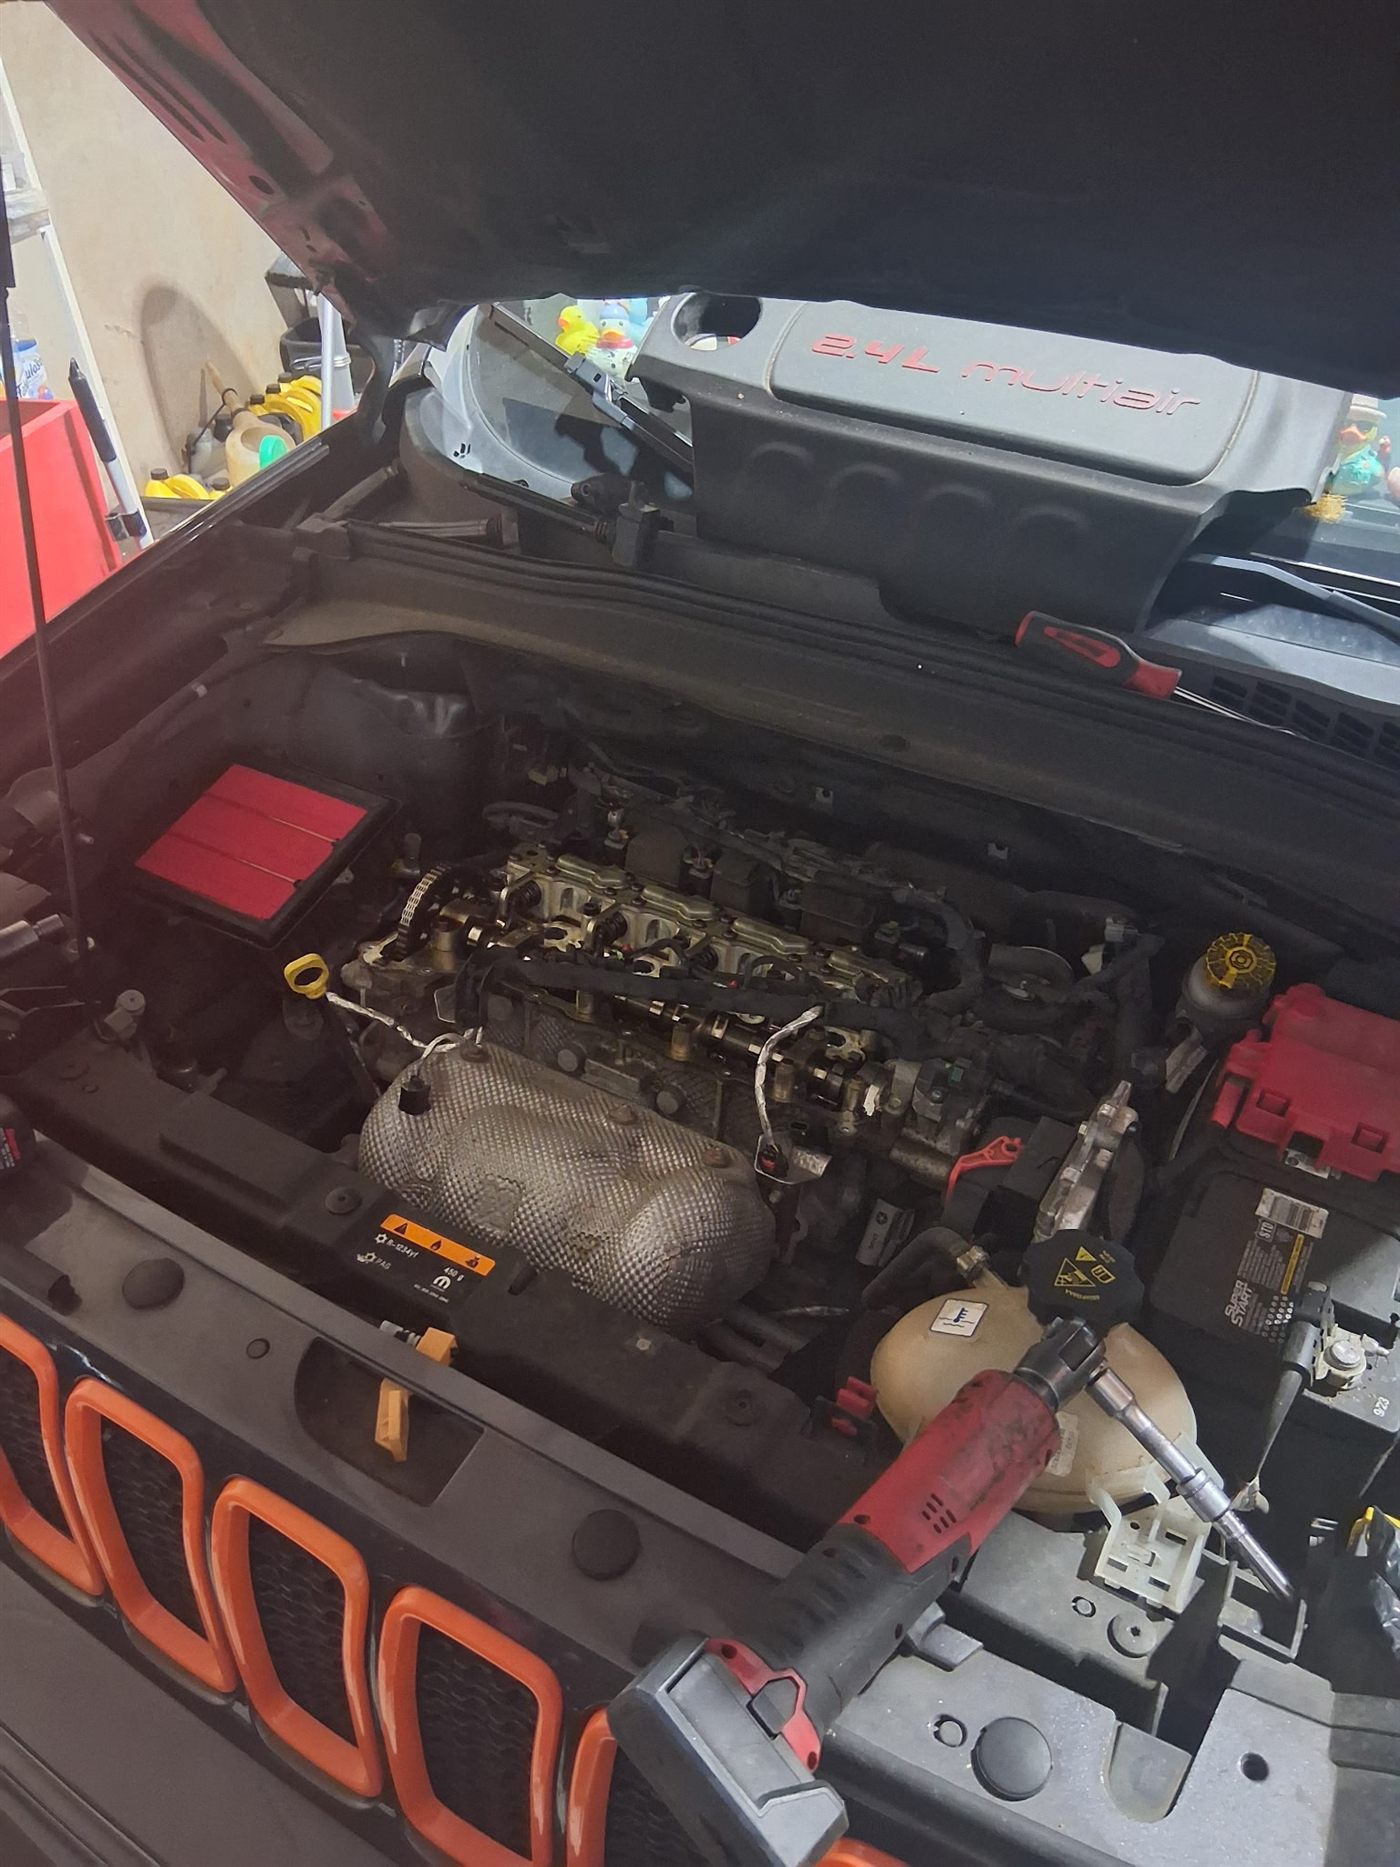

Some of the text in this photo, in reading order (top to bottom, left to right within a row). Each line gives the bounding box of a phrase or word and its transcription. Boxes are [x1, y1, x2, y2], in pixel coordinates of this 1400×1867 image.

[811, 332, 1201, 416] 2.4L multiair
[1225, 1280, 1248, 1316] SUPER
[1231, 1288, 1252, 1327] START
